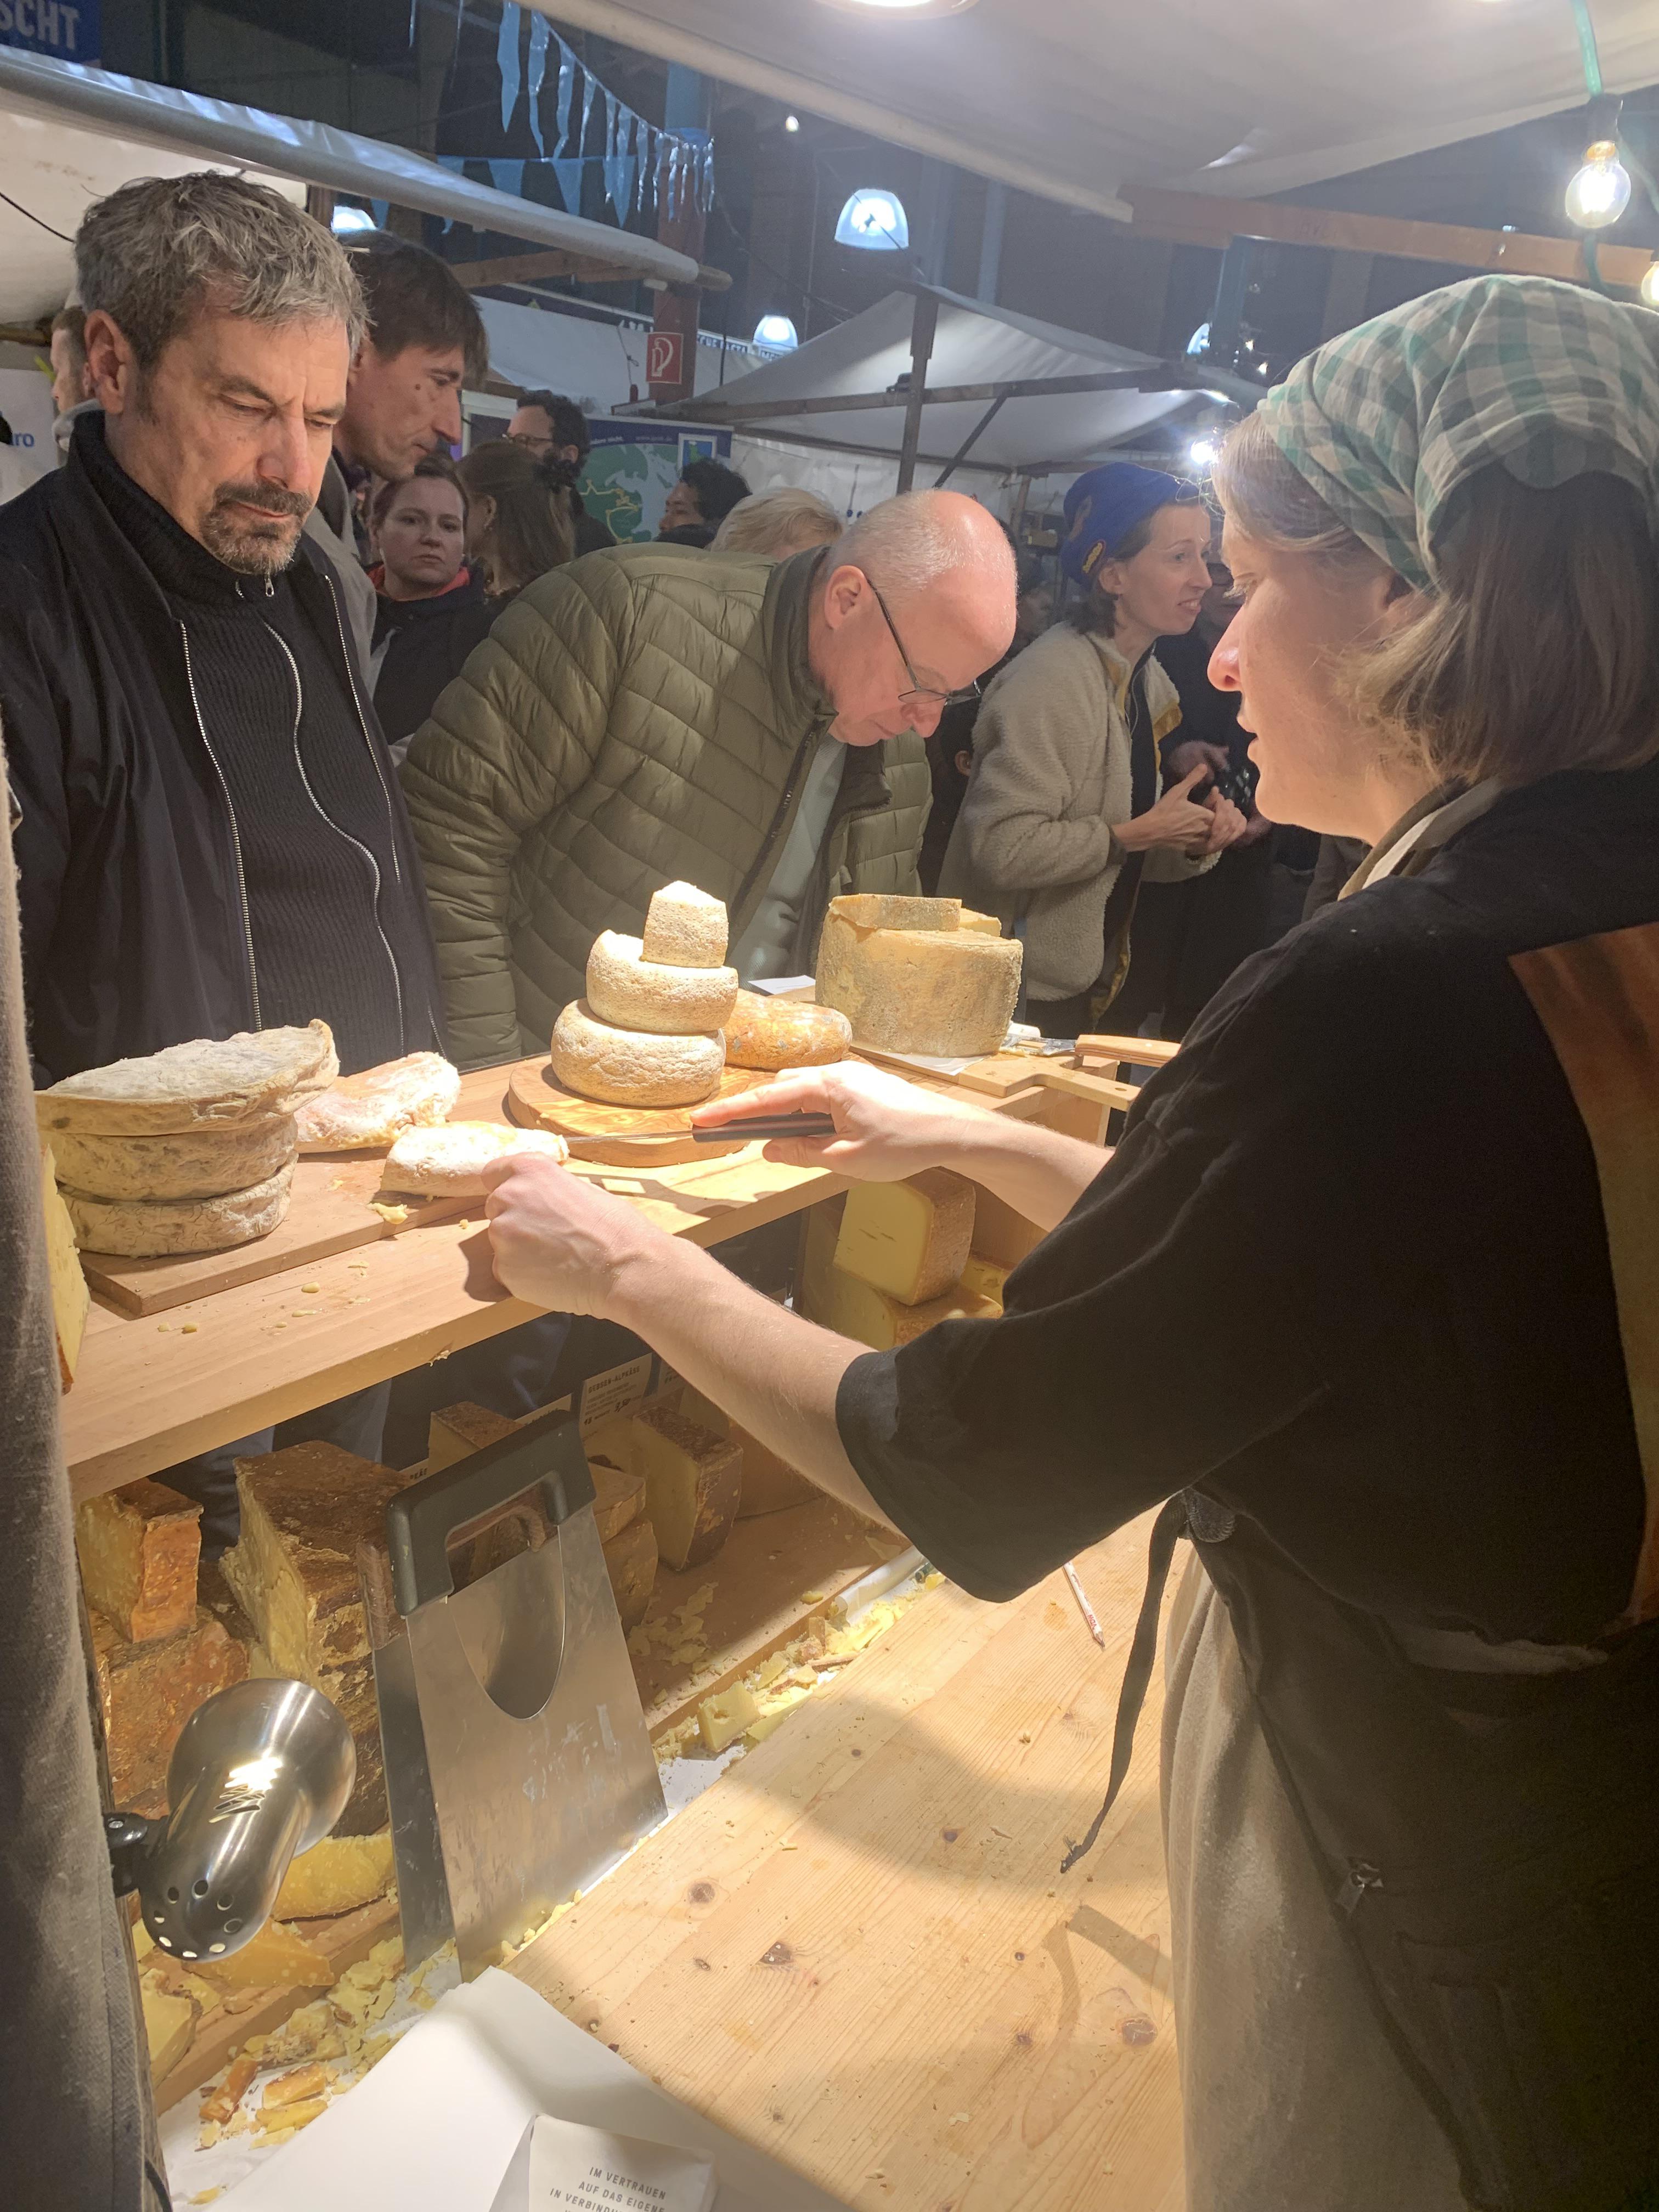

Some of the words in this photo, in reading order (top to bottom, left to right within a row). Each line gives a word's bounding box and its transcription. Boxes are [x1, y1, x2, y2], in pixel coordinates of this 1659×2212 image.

[550, 2188, 562, 2198] IN
[579, 2181, 600, 2194] AUF
[602, 2189, 623, 2203] DAS
[589, 2166, 603, 2179] IM
[606, 2172, 666, 2200] VERTRAUEN
